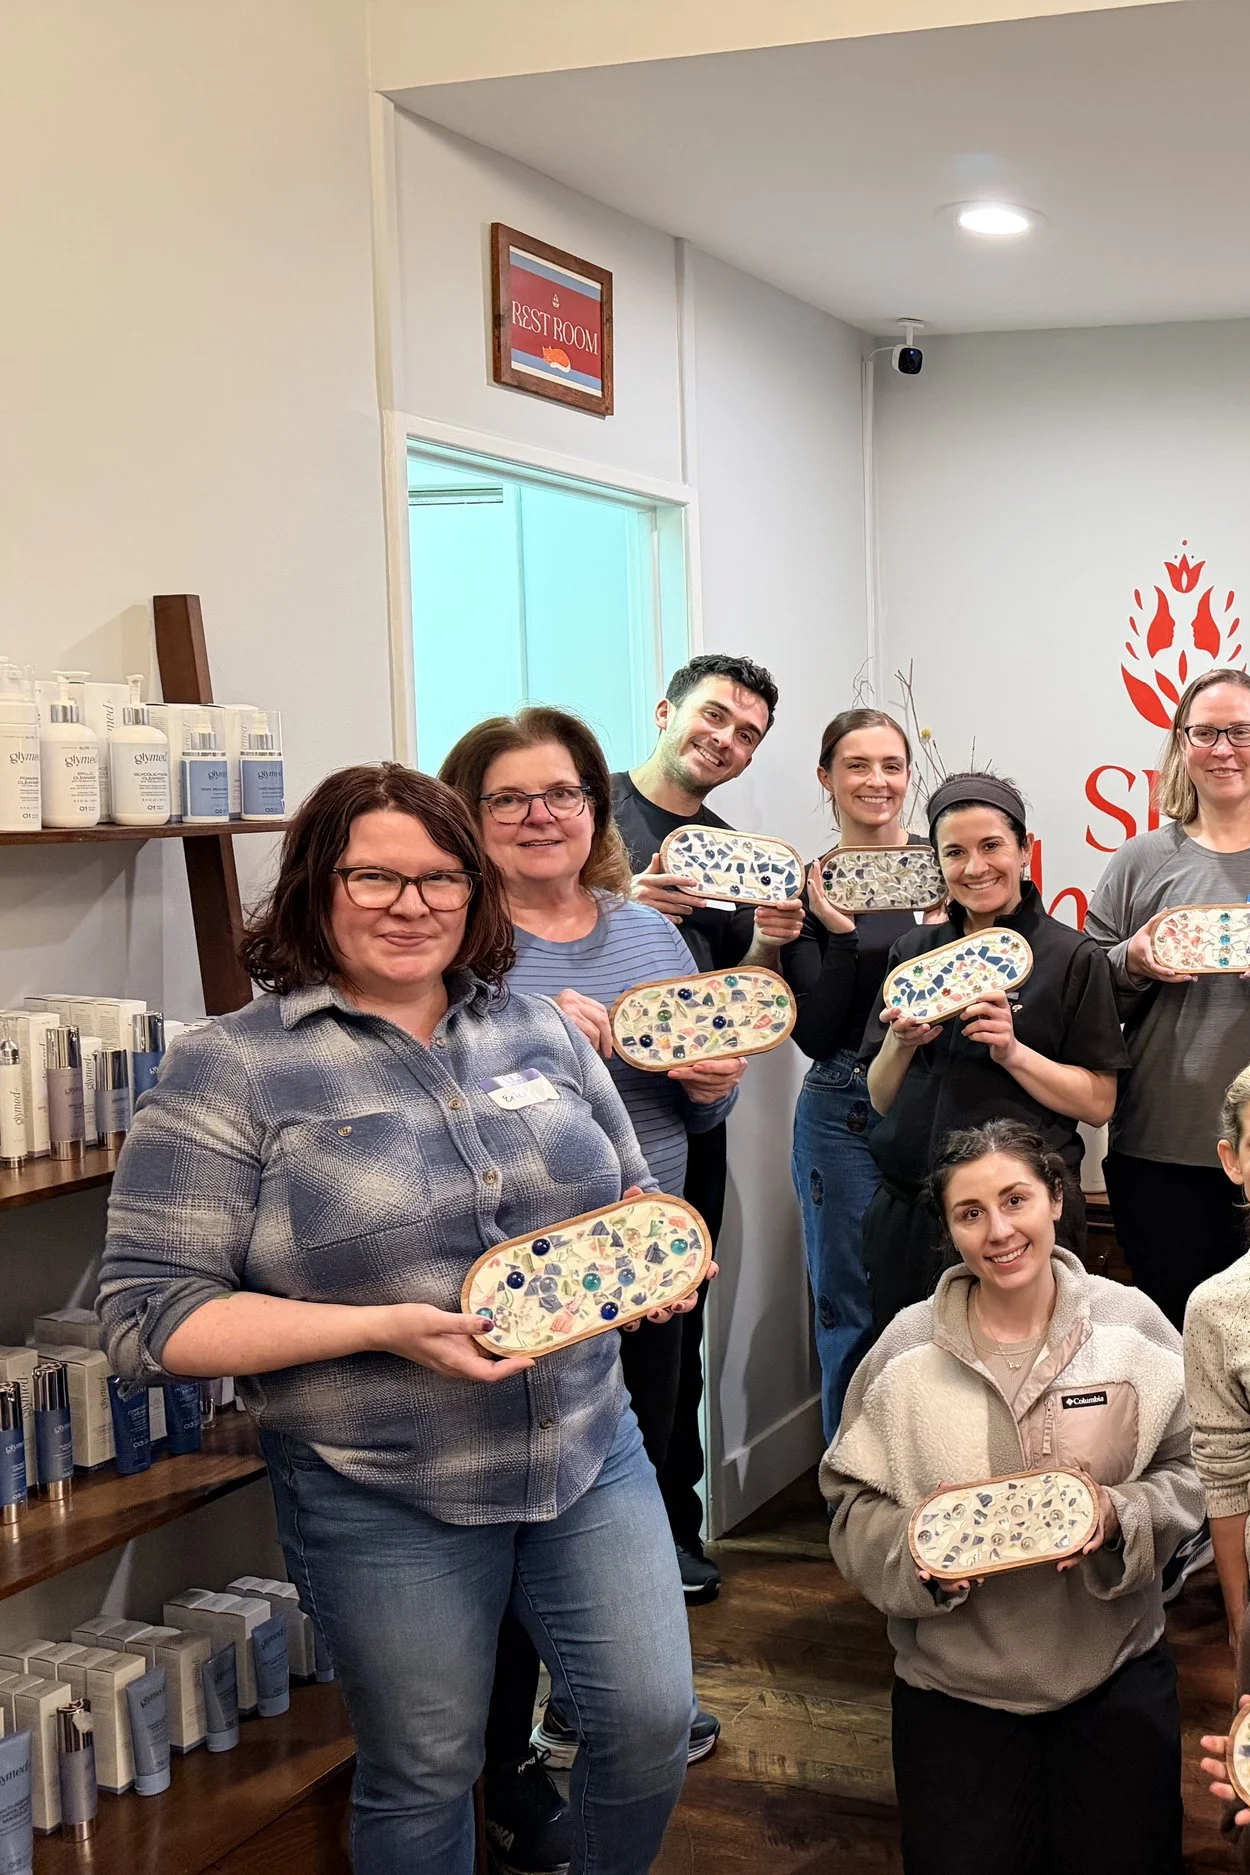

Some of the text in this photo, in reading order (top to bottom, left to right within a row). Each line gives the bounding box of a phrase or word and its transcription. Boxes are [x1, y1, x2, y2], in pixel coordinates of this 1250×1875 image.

[511, 300, 599, 355] REST ROOM
[1072, 1394, 1105, 1406] Columbia
